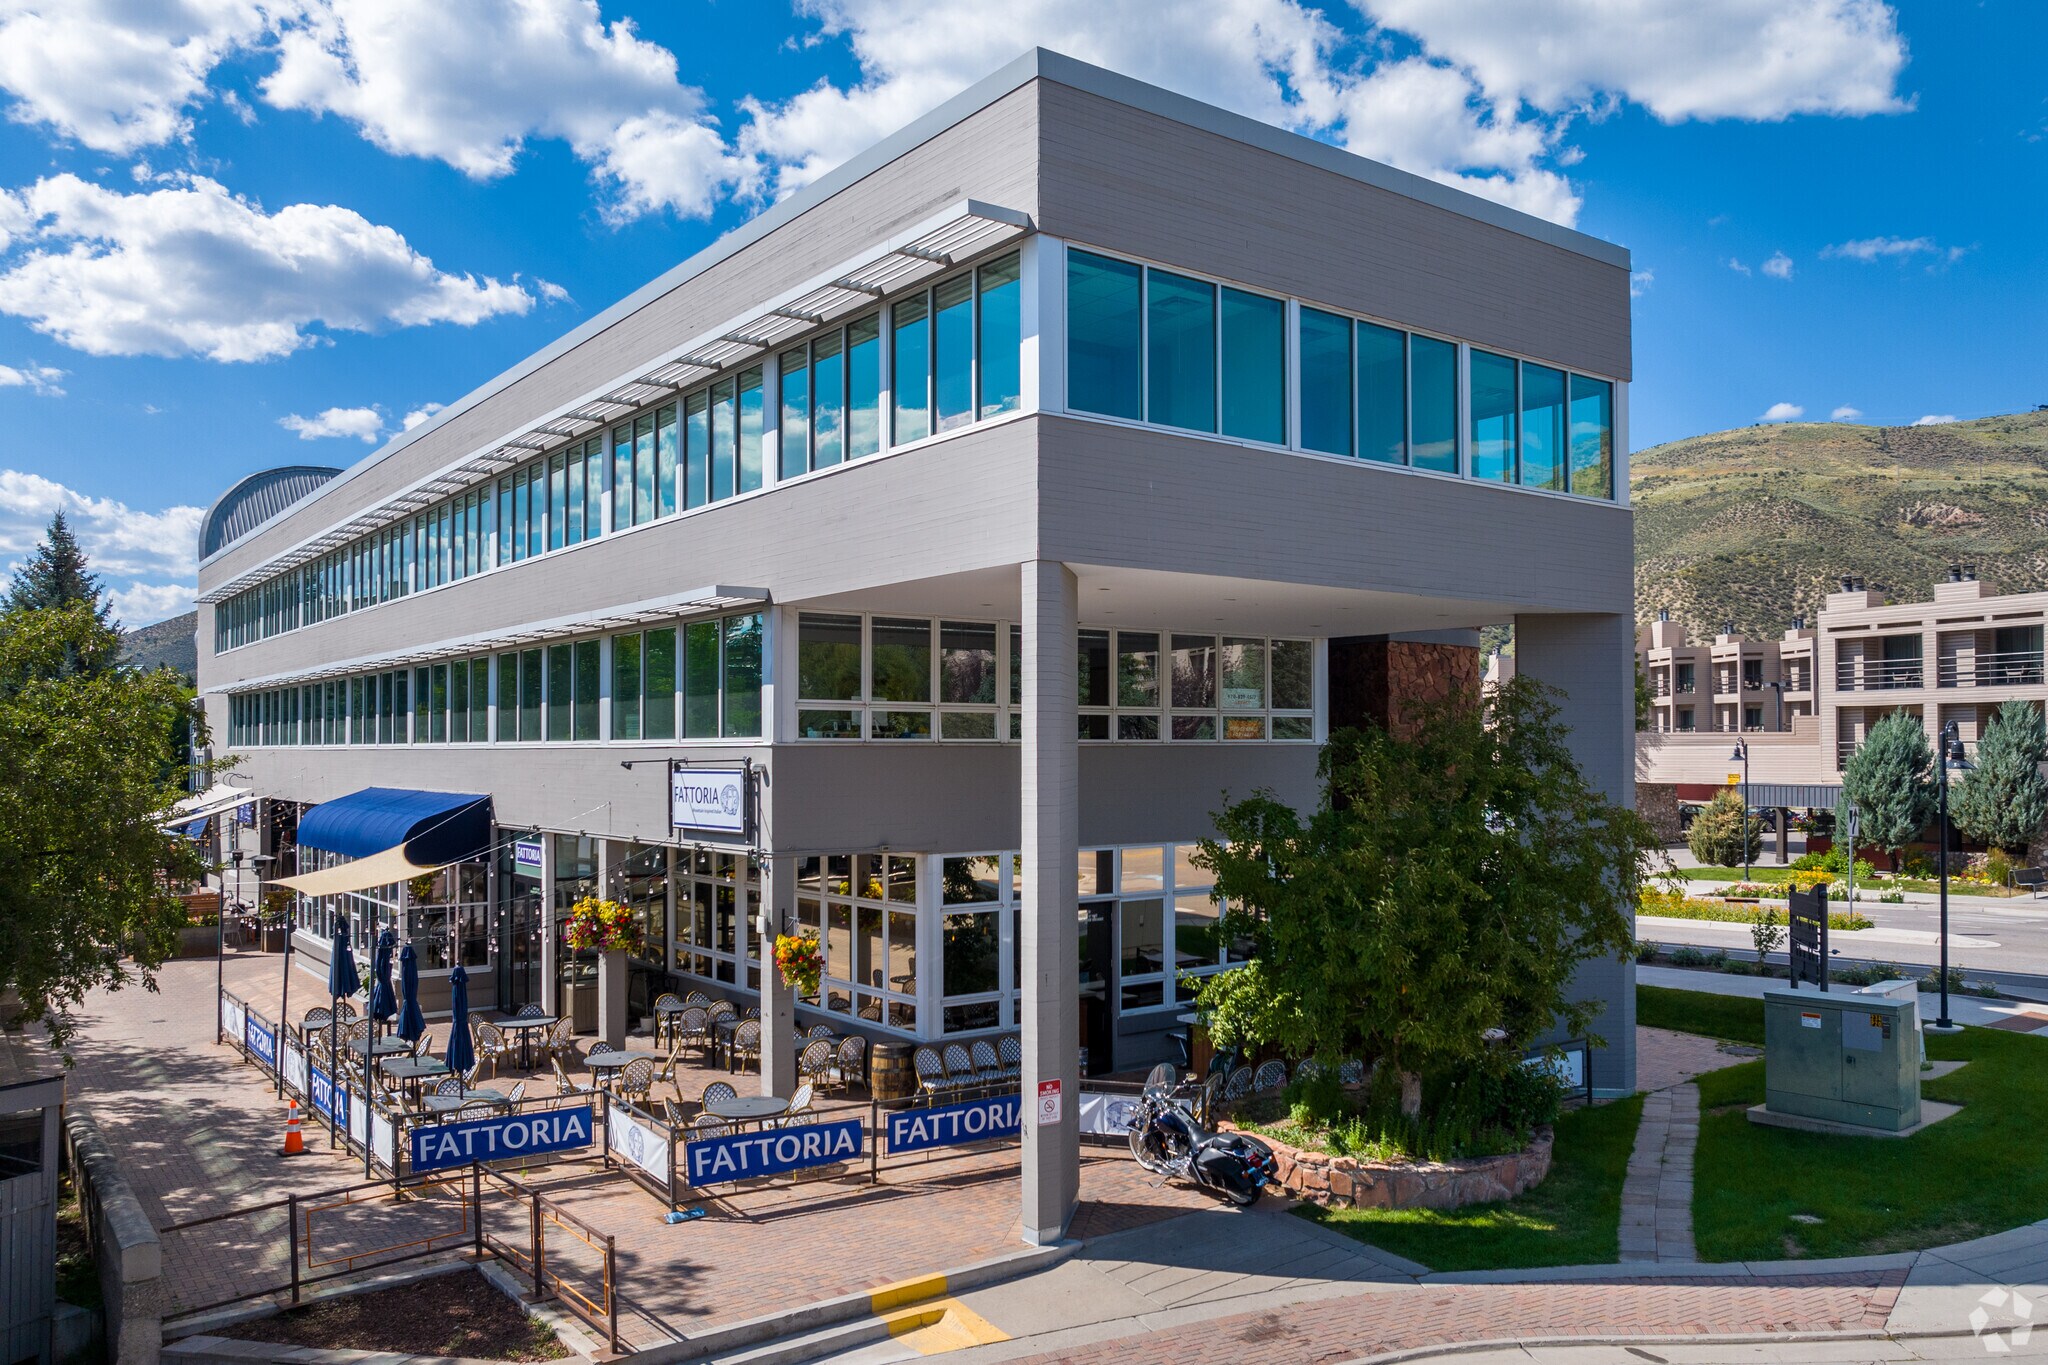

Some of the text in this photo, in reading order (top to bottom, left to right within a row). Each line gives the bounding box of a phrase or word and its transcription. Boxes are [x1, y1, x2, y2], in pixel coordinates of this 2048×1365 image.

[674, 786, 719, 805] FATTORIA
[517, 846, 541, 862] FATTORIA
[248, 1021, 274, 1059] FATTORIA
[312, 1073, 345, 1120] FATTOIA
[1040, 1088, 1060, 1096] SMOKING
[420, 1114, 586, 1162] FATTORIA
[695, 1128, 856, 1177] FATTORIA
